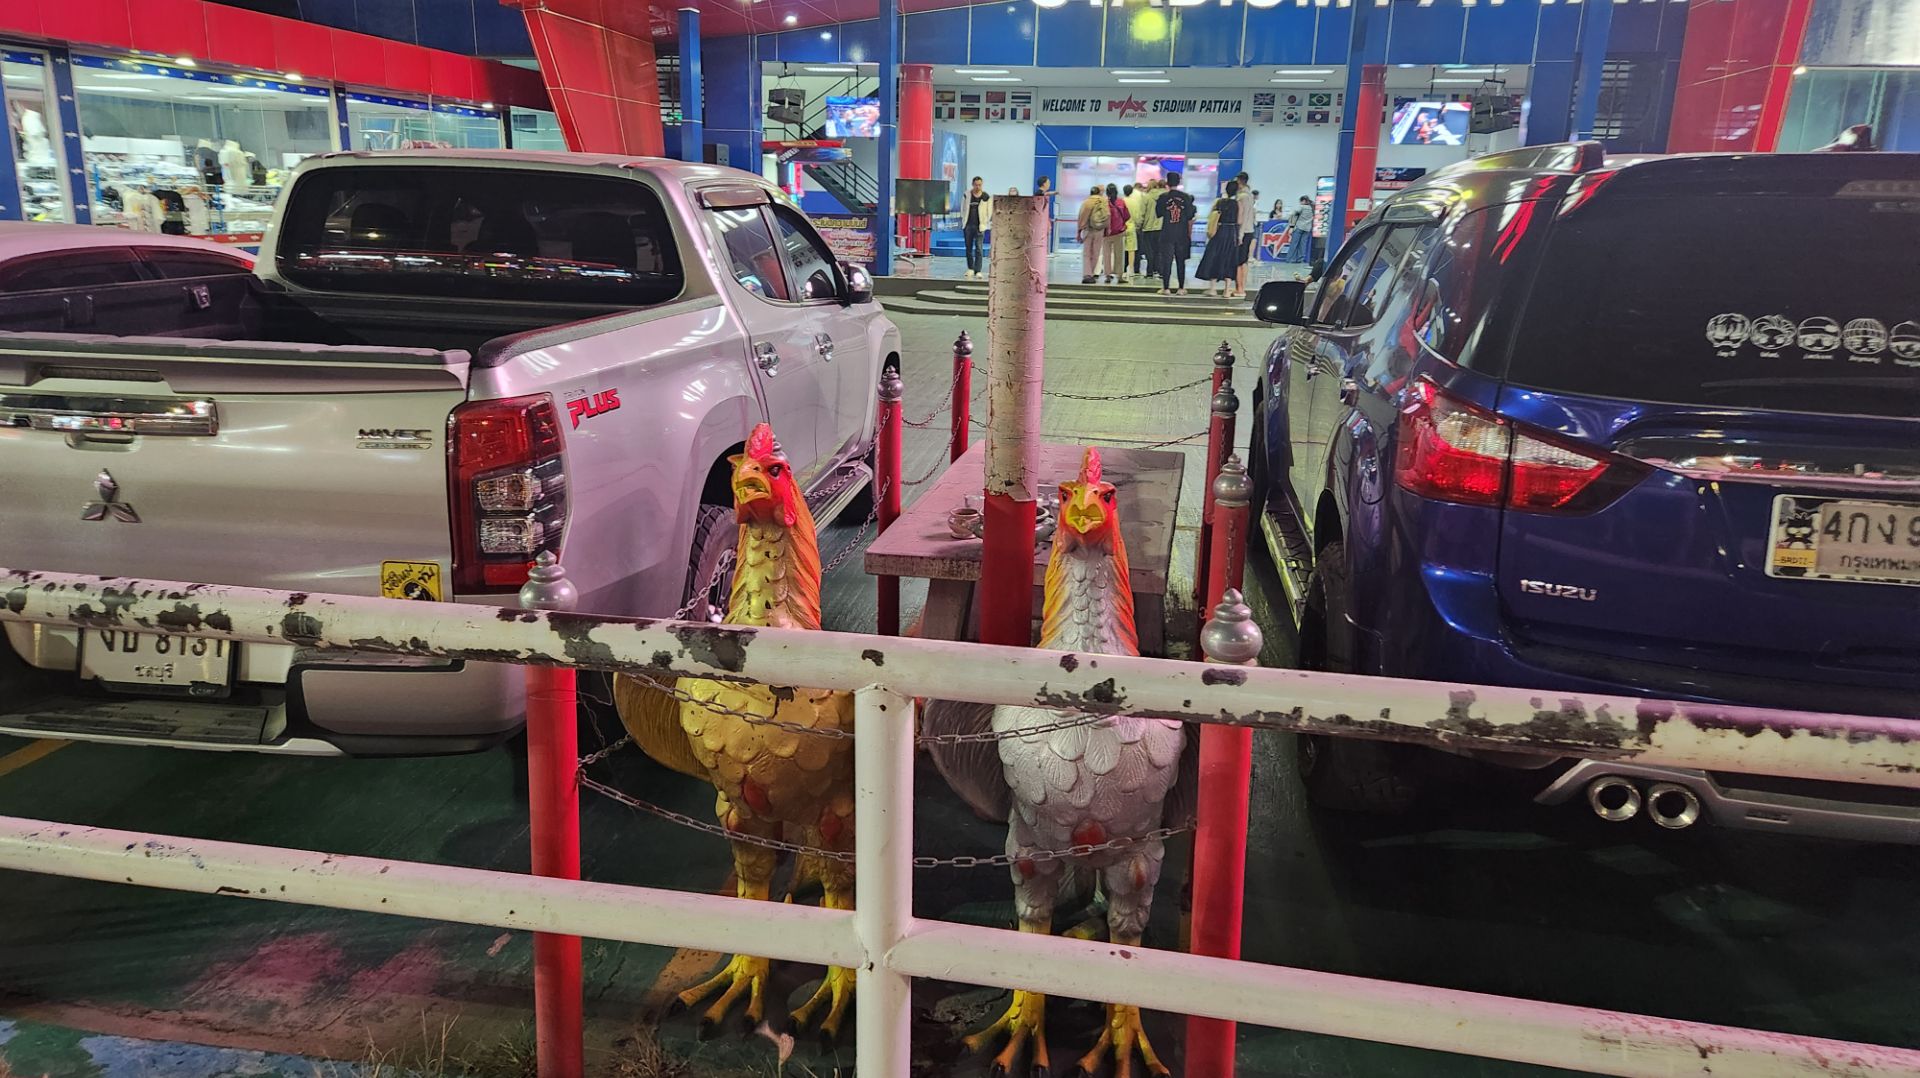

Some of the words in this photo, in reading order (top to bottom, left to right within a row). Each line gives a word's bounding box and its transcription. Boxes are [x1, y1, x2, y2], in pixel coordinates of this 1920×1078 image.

[1042, 98, 1087, 112] WELCOME
[1090, 99, 1101, 112] TO
[1107, 92, 1148, 120] MAX
[1152, 99, 1196, 113] STADIUM
[1199, 99, 1242, 113] PATTAYA
[566, 388, 621, 430] PLUS
[356, 429, 433, 440] MIVEC
[1824, 511, 1896, 545] 4กง
[1520, 578, 1598, 602] ISUZU
[135, 662, 174, 682] ชลบุรี
